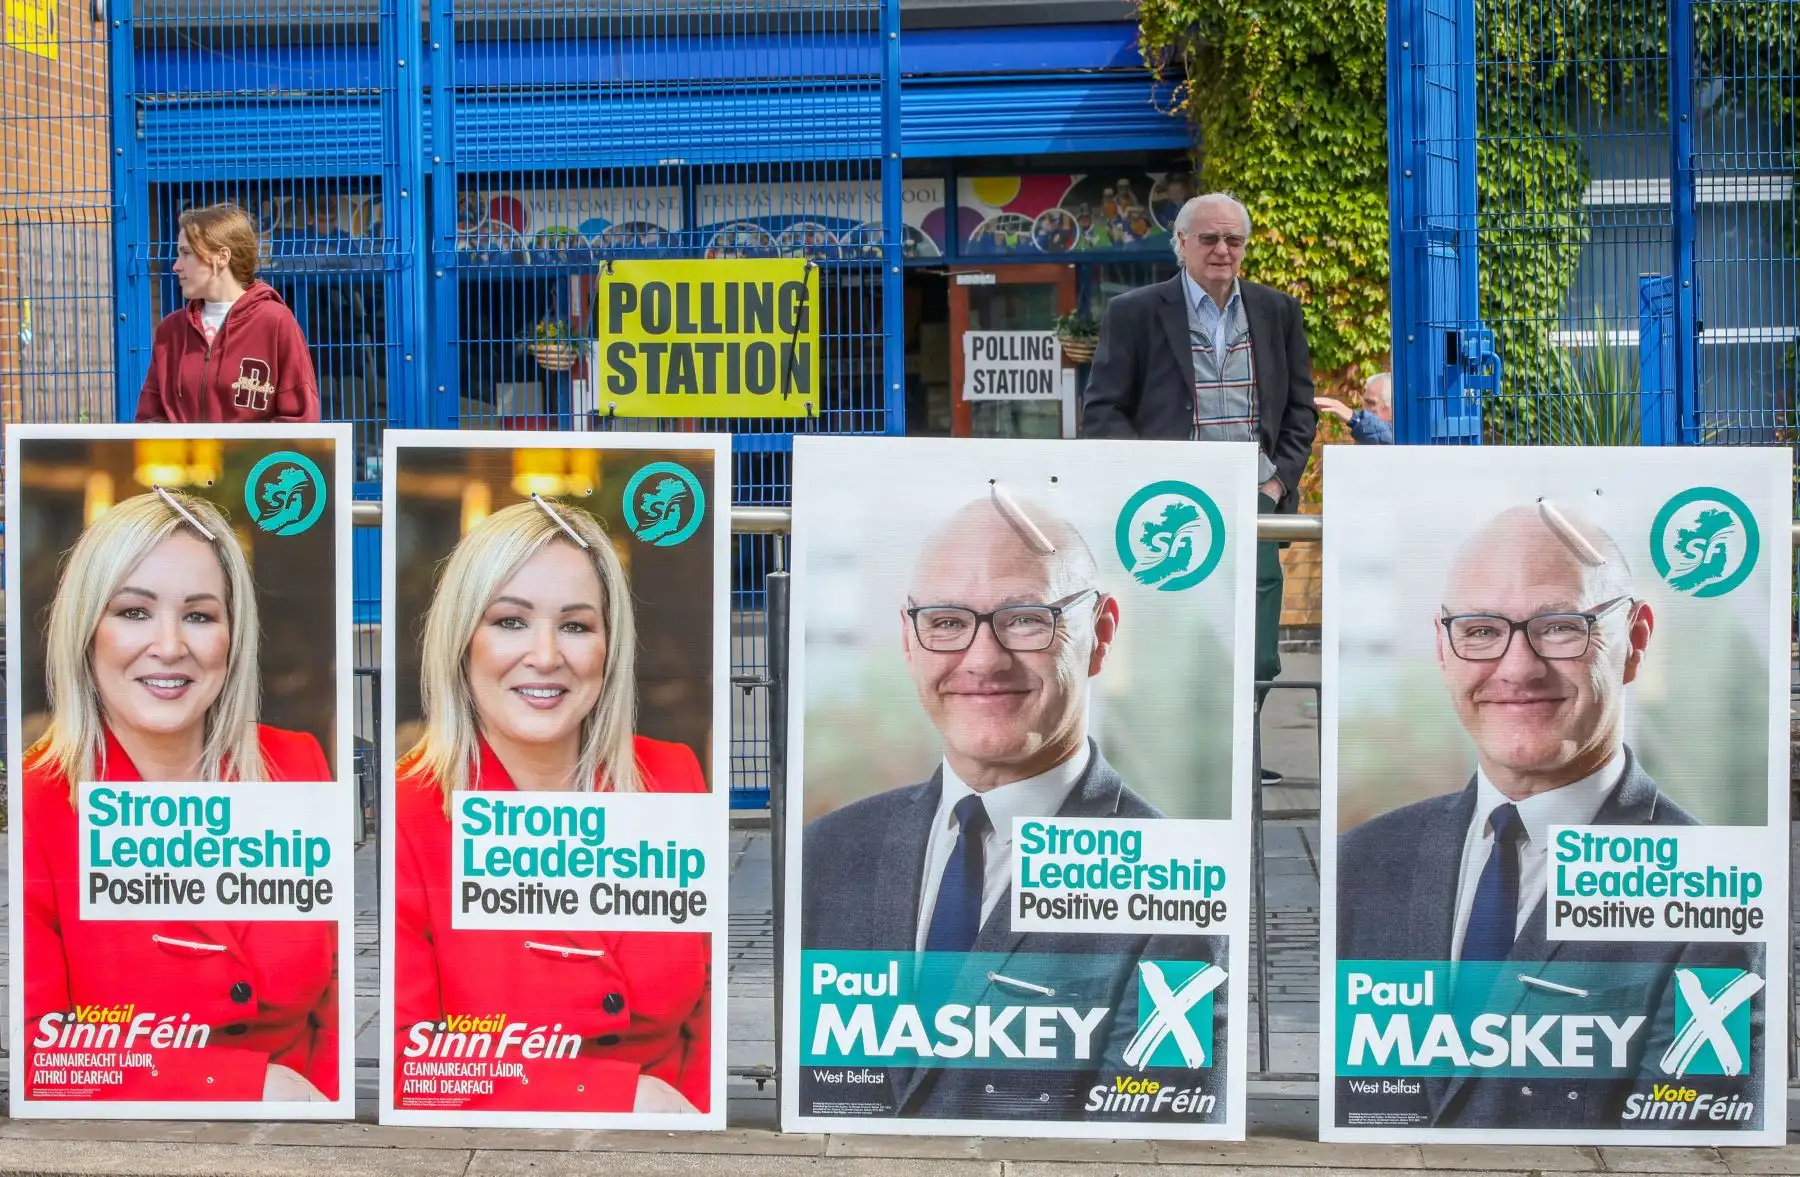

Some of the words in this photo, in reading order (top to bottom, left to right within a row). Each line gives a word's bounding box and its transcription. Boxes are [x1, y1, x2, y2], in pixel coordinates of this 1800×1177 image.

[625, 197, 650, 212] TO
[777, 190, 858, 206] PRMARY
[864, 188, 939, 204] SCOOL
[609, 281, 810, 335] POLLING
[972, 336, 1054, 361] POLLING
[606, 341, 811, 396] STATION
[973, 369, 1053, 394] STATION
[88, 788, 231, 836] Strong
[461, 797, 606, 846] Strong
[89, 829, 331, 877] Leadership
[1020, 821, 1142, 864] Strong
[1555, 829, 1678, 871] Strong
[463, 838, 706, 888] Leadership
[1021, 856, 1226, 898] Leadership
[89, 872, 206, 905] Positive
[216, 872, 333, 913] Change
[462, 881, 579, 915] Positive
[589, 883, 707, 924] Change
[1557, 864, 1763, 905] Leadership
[1019, 892, 1119, 920] Positive
[1127, 893, 1227, 929] Change
[1555, 900, 1655, 928] Positive
[1664, 901, 1764, 936] Change
[813, 960, 898, 997] Paul
[1348, 970, 1434, 1007] Paul
[33, 1012, 121, 1049] Sinn
[124, 1013, 211, 1049] Féin
[75, 1004, 135, 1023] Vótáil
[446, 1013, 507, 1033] Vótáil
[811, 1003, 1111, 1060] MASKEY
[403, 1021, 492, 1058] Sinn
[495, 1022, 582, 1059] Féin
[1346, 1013, 1647, 1068] MASKEY
[33, 1053, 116, 1068] CEANNAIREACHT
[119, 1050, 156, 1070] LÁIDIR,
[33, 1068, 67, 1085] ATHRÚ
[70, 1070, 123, 1085] DEARFACH
[403, 1061, 486, 1076] CEANNAIREACHT
[489, 1060, 527, 1080] LÁIDIR,
[813, 1069, 844, 1083] West
[847, 1068, 885, 1084] Belfast
[403, 1077, 437, 1094] ATHRÚ
[440, 1079, 493, 1095] DEARFACH
[1084, 1085, 1150, 1113] Sinn
[1151, 1086, 1216, 1114] Féin
[1115, 1076, 1161, 1095] Vote
[1348, 1080, 1379, 1094] West
[1383, 1079, 1421, 1094] Belfast
[1652, 1083, 1698, 1102] Vote
[1621, 1093, 1687, 1120] Sinn
[1689, 1094, 1754, 1121] Féin
